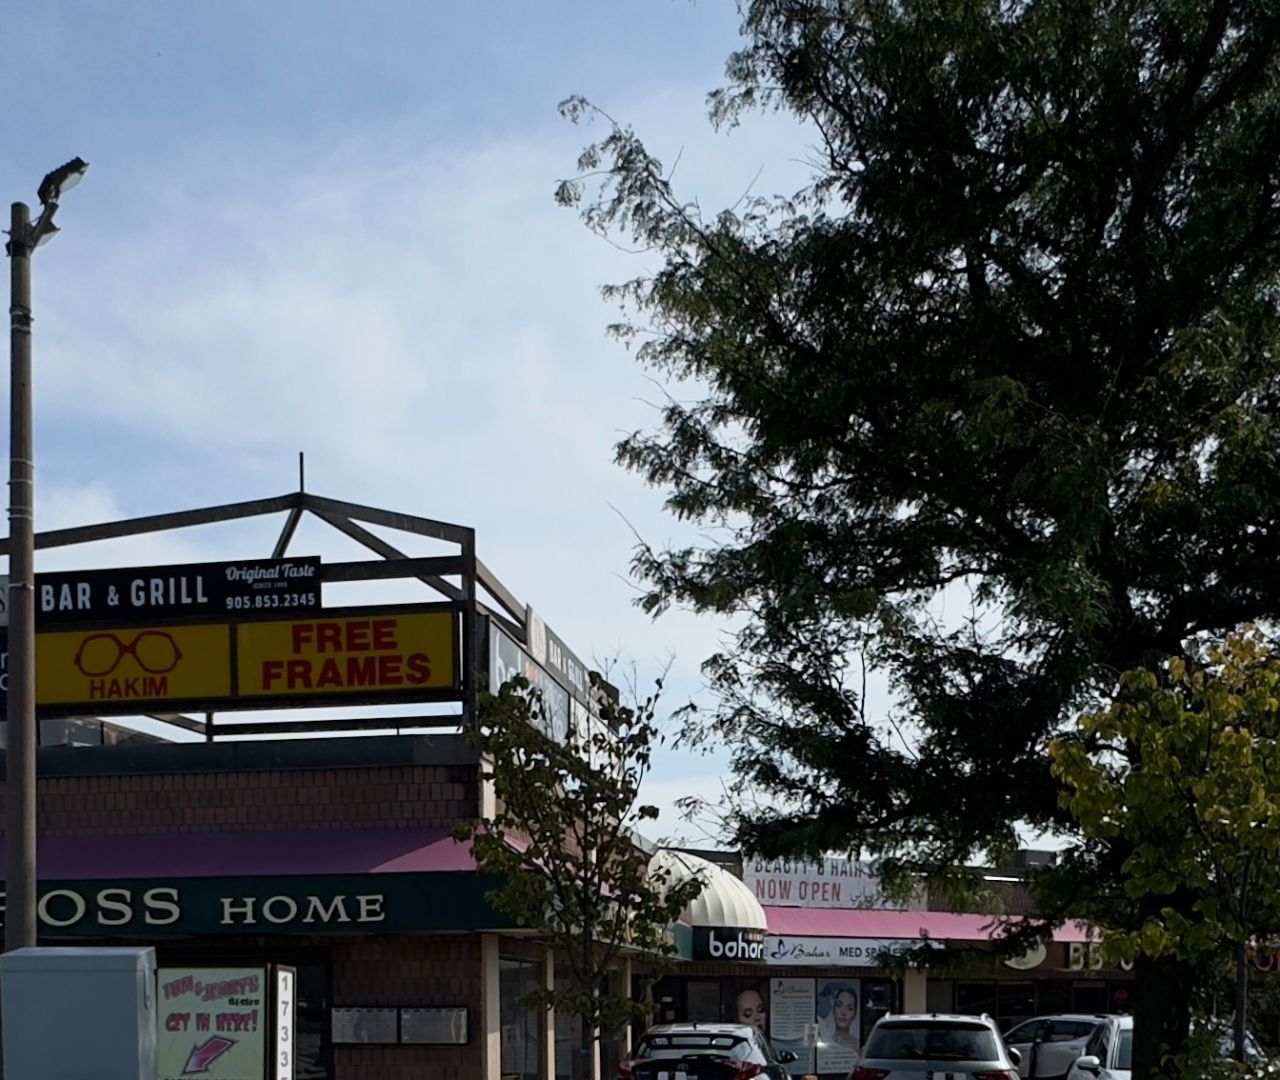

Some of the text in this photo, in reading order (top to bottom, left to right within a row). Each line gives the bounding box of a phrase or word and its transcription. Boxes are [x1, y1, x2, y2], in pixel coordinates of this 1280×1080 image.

[225, 563, 316, 584] Original Taste
[40, 581, 91, 612] BAR
[107, 585, 120, 606] &
[130, 575, 209, 607] GRILL
[225, 592, 316, 610] 905.853.2345
[291, 618, 398, 655] FREE
[261, 652, 432, 691] FRAMES
[89, 675, 168, 699] HAKIM
[756, 879, 792, 900] NOW
[799, 881, 842, 902] OPEN
[219, 893, 386, 925] HOME
[708, 929, 764, 959] bahar
[839, 946, 862, 958] MED
[165, 1009, 259, 1033] GET IN HERE!
